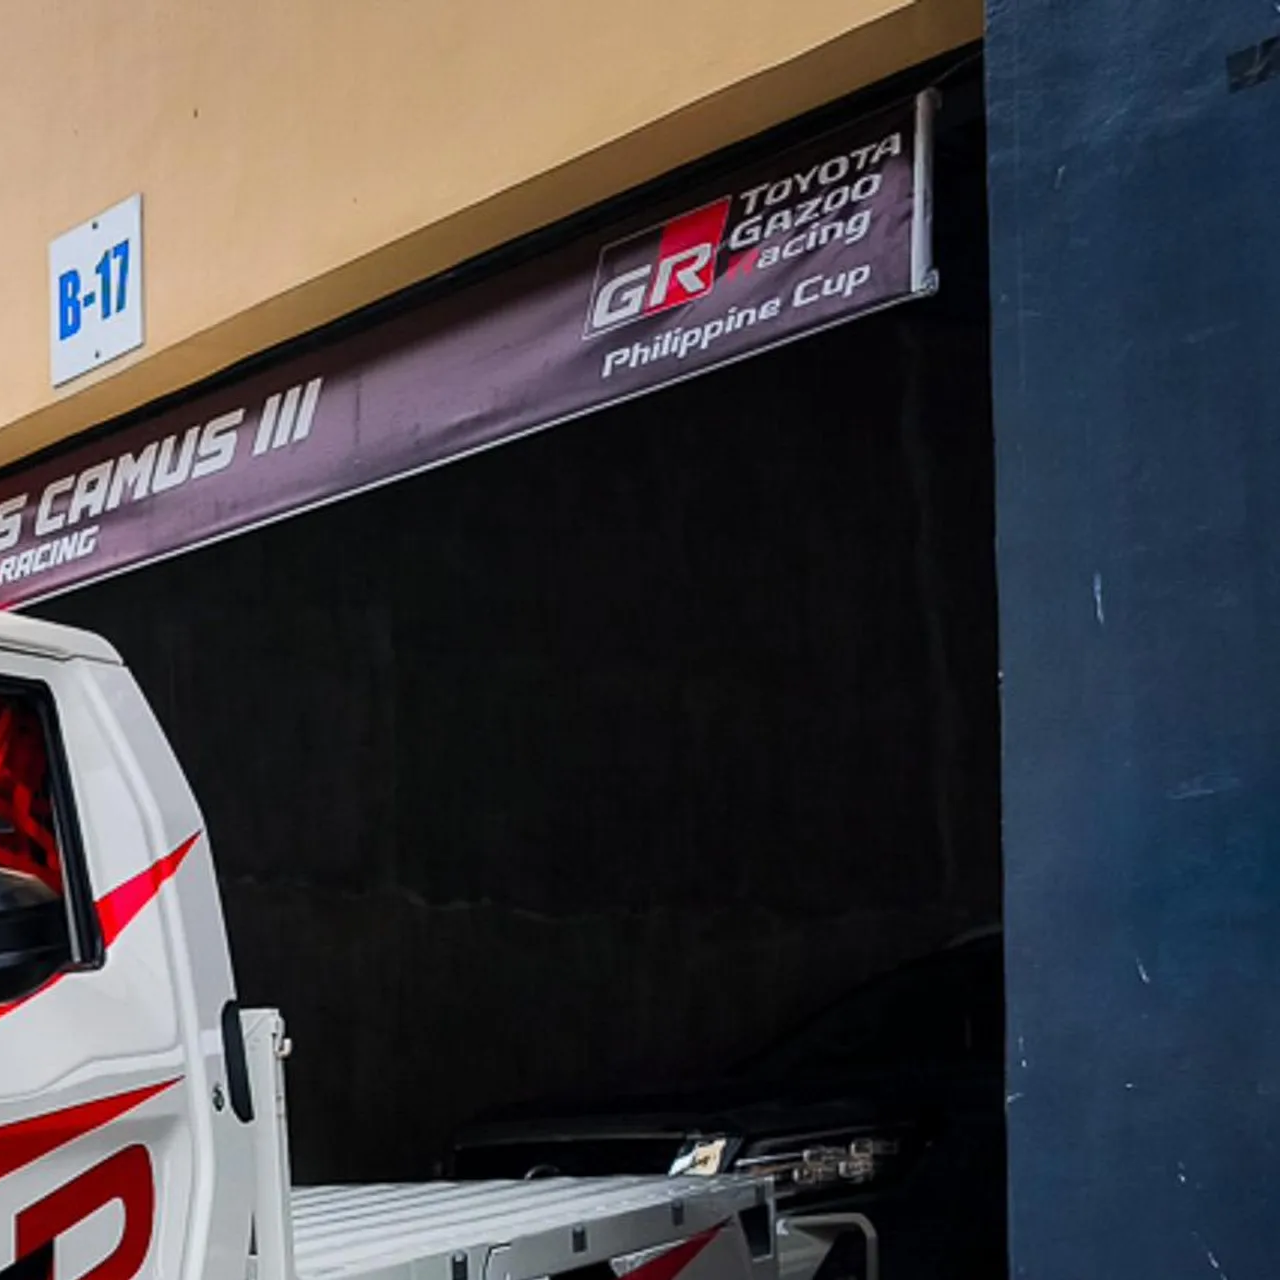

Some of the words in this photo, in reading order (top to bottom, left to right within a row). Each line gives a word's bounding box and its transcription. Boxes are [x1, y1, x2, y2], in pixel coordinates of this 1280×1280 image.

[729, 172, 883, 250] GAZOO
[740, 132, 902, 216] TOYOTA
[58, 238, 129, 341] B-17
[592, 242, 713, 329] GR
[601, 296, 781, 378] Philippine
[792, 264, 871, 308] Cup
[36, 409, 246, 536] CAMUS
[253, 377, 324, 455] III
